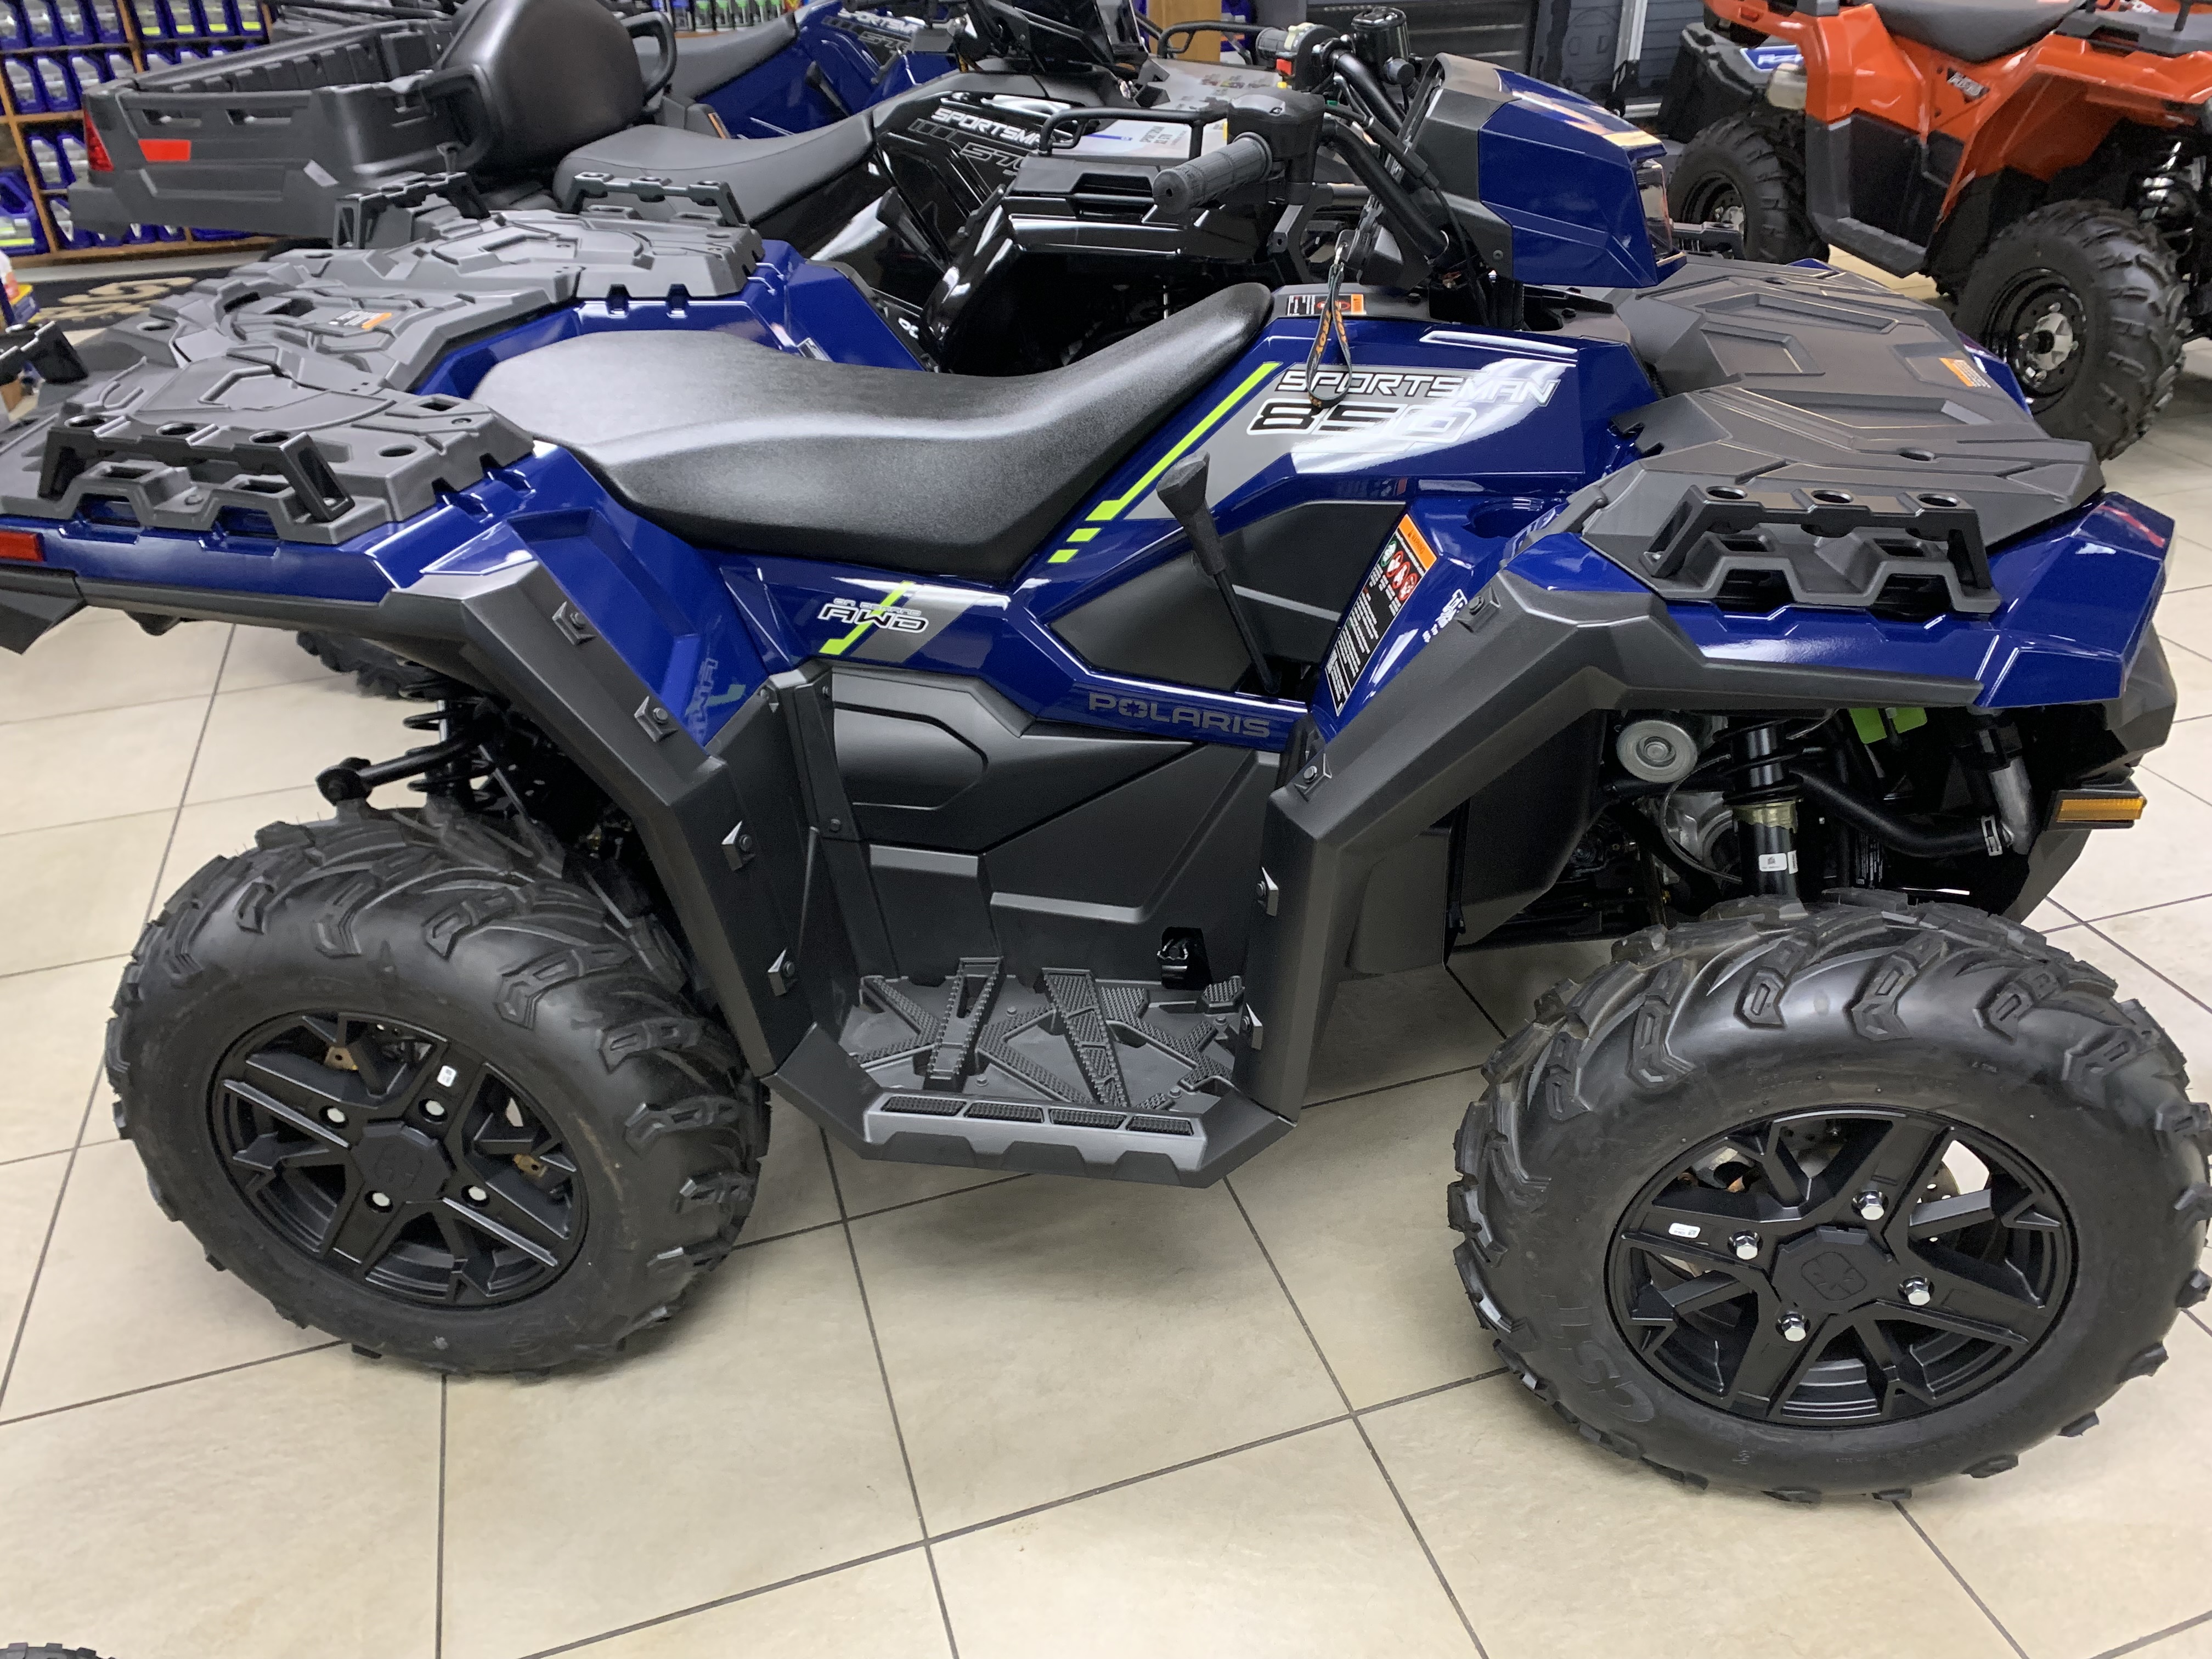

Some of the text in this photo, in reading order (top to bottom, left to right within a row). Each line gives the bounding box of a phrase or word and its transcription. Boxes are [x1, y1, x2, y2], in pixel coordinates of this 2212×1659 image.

[959, 142, 1024, 171] 57
[1274, 369, 1561, 407] SPORTSMAN
[1246, 398, 1477, 444] 850
[817, 602, 929, 634] AWD
[859, 601, 922, 617] DEMAND
[1088, 693, 1271, 738] POLARIS
